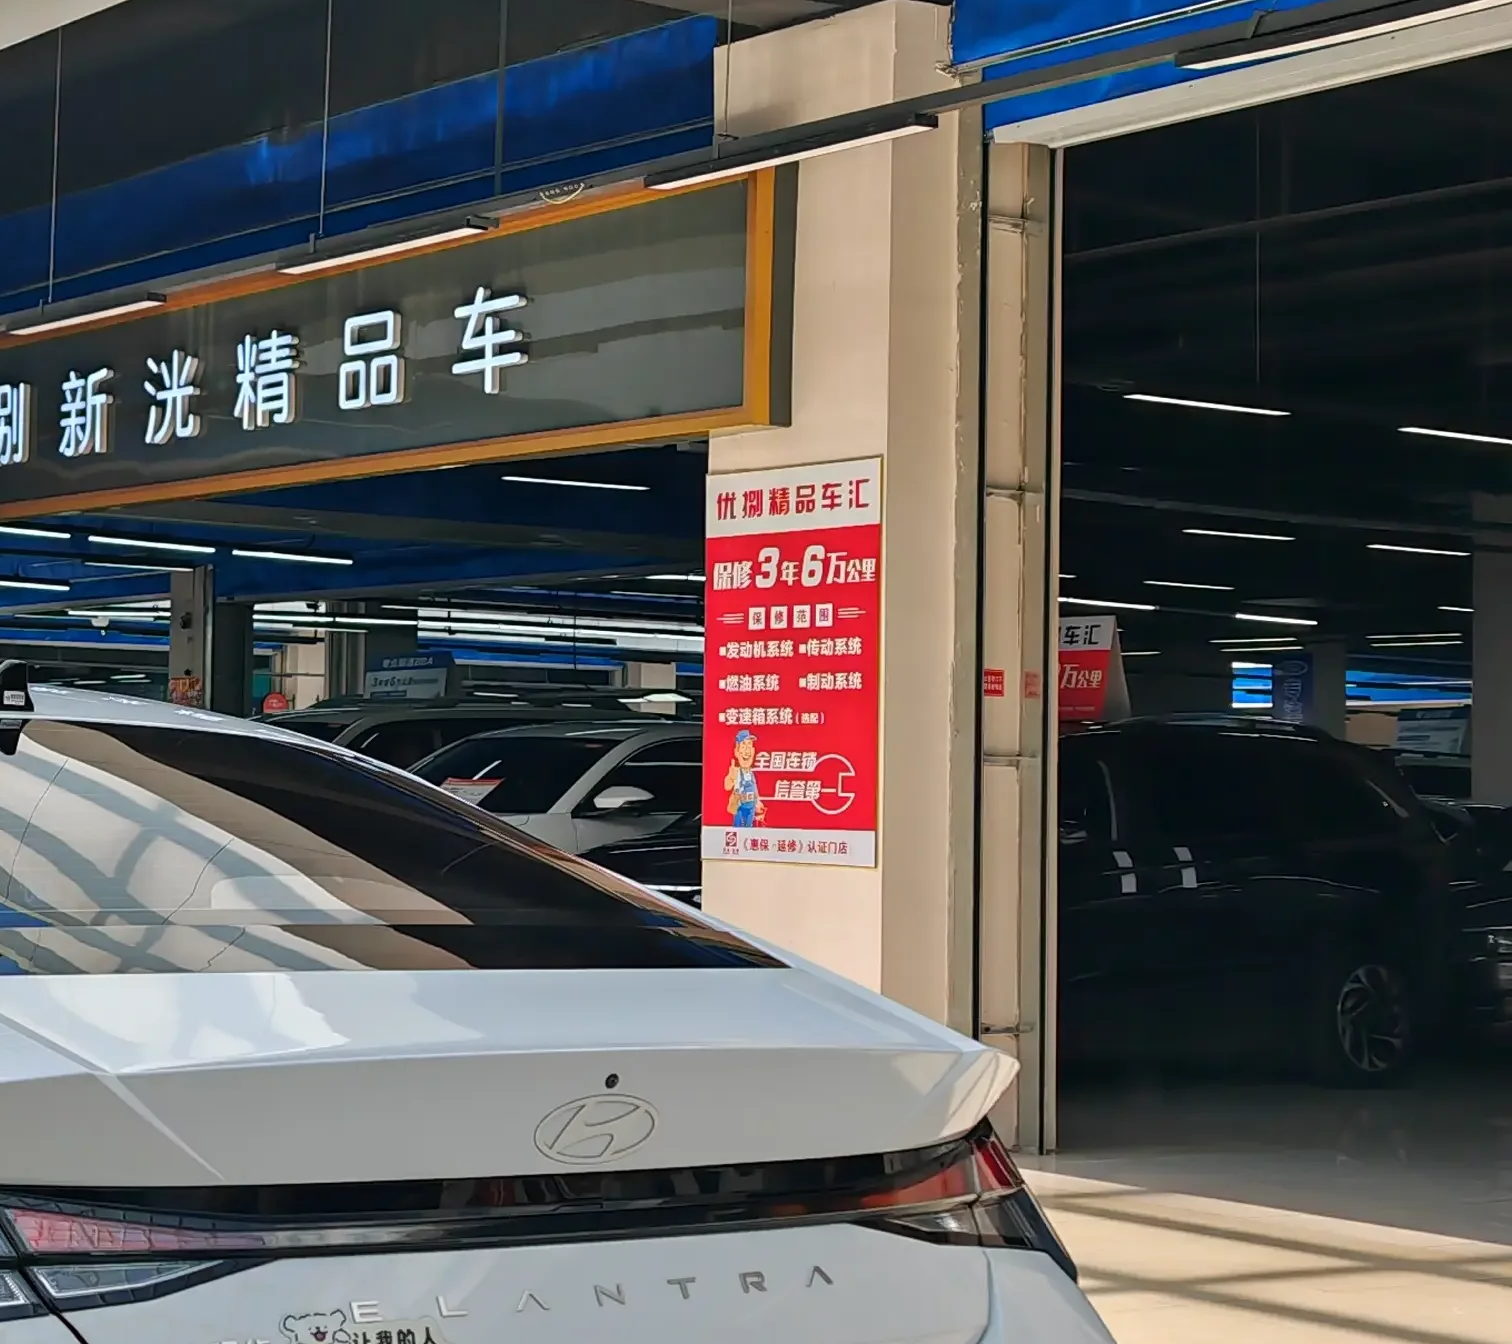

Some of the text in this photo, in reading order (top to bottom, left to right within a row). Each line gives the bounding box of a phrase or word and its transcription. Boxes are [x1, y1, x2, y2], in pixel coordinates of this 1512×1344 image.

[716, 478, 871, 520] 优捌精品车汇
[713, 545, 877, 591] 保修3年6万公里
[725, 636, 863, 659] 发动机系统 传动系统
[725, 671, 863, 692] 燃油系统 制动系统
[754, 751, 818, 770] 全国连锁
[774, 779, 837, 800] 信誉第一
[349, 1265, 834, 1324] ELANTRA
